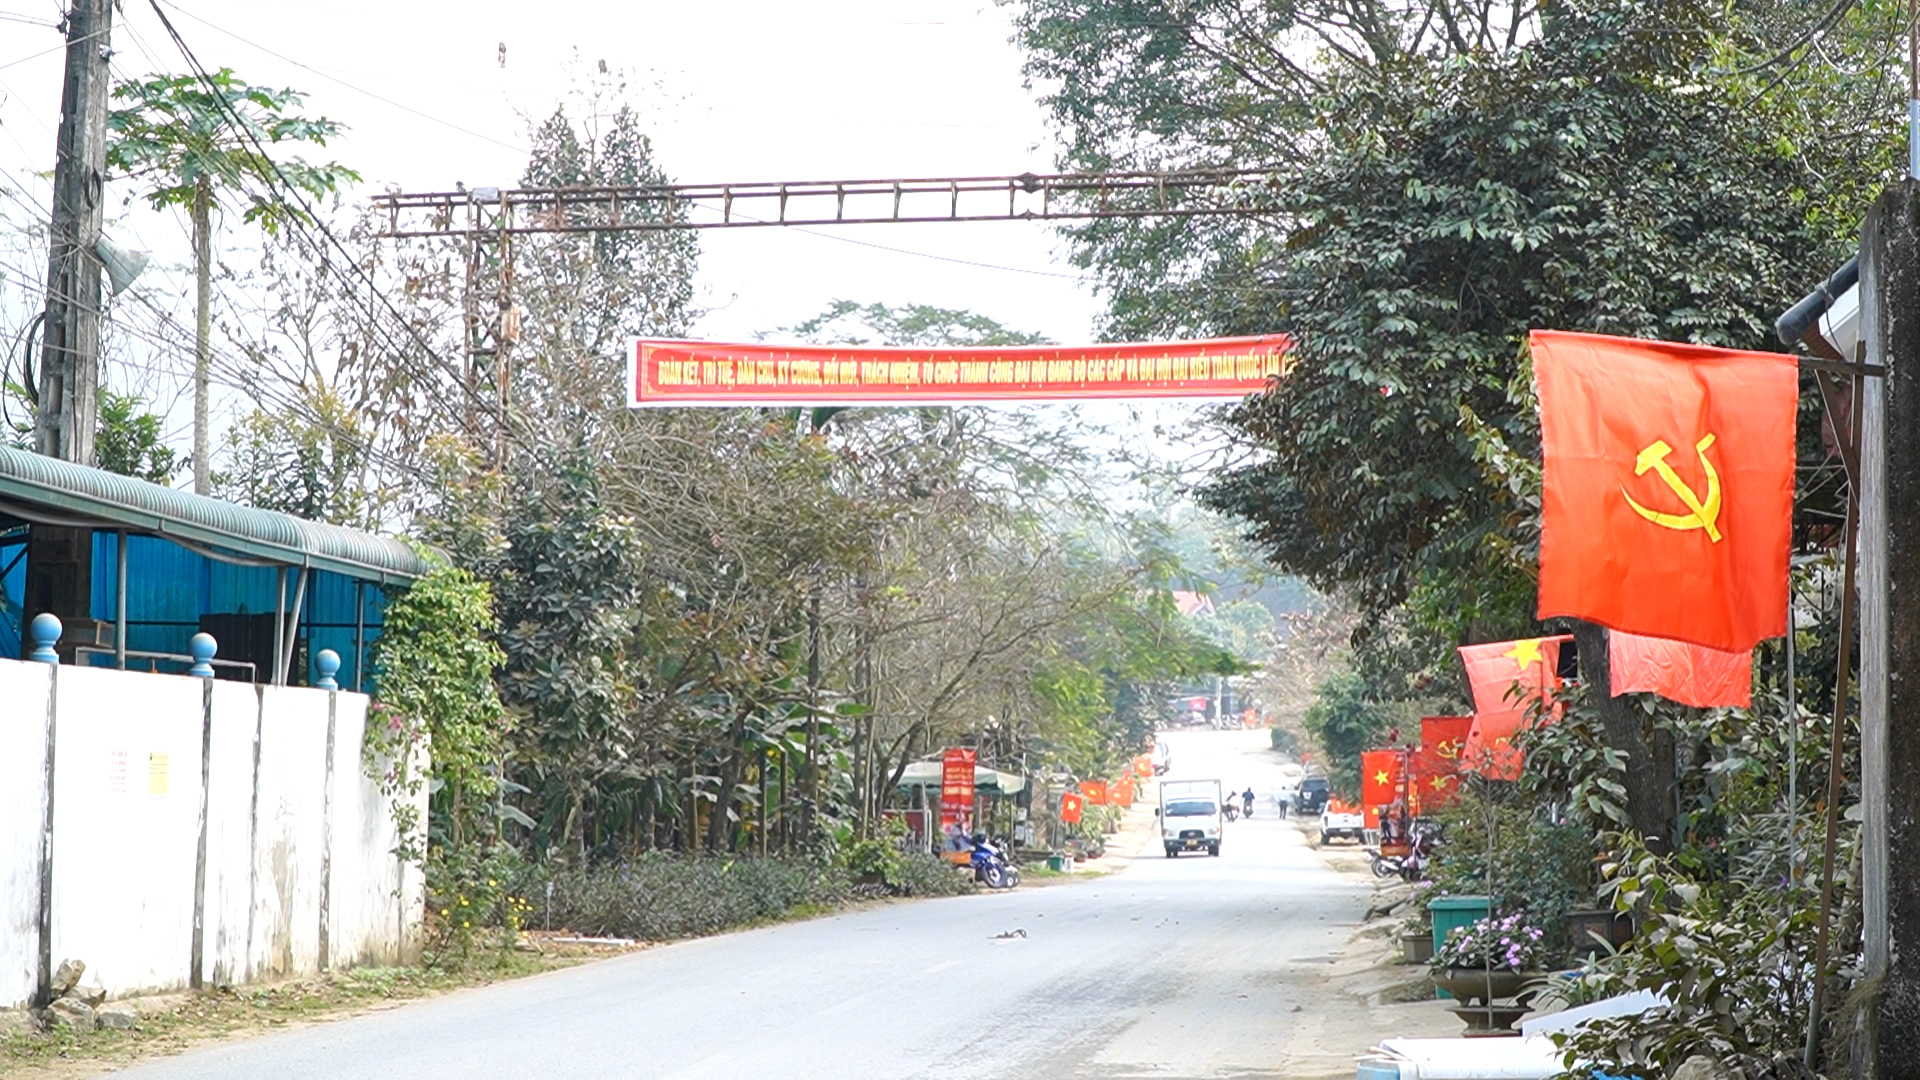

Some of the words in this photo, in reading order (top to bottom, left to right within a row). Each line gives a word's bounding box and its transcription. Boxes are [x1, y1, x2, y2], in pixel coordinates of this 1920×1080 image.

[703, 356, 716, 385] TRÍ
[737, 356, 755, 385] DÂN
[861, 357, 889, 385] TRÁCH
[935, 355, 958, 384] CHỨC
[960, 356, 988, 383] THÀNH
[989, 356, 1014, 384] CÔNG
[1015, 359, 1031, 389] ĐẠI
[1031, 356, 1047, 389] HỘI
[1048, 351, 1073, 383] ĐẢNG
[1073, 354, 1086, 388] BỘ
[1087, 354, 1106, 383] CÁC
[1107, 351, 1125, 382] CẤP
[1126, 353, 1139, 382] VÀ
[1139, 357, 1154, 387] ĐẠI
[1156, 353, 1171, 387] HỘI
[1173, 357, 1188, 387] ĐẠI
[1212, 351, 1234, 380] TOÀN
[1236, 347, 1260, 382] QUỐC
